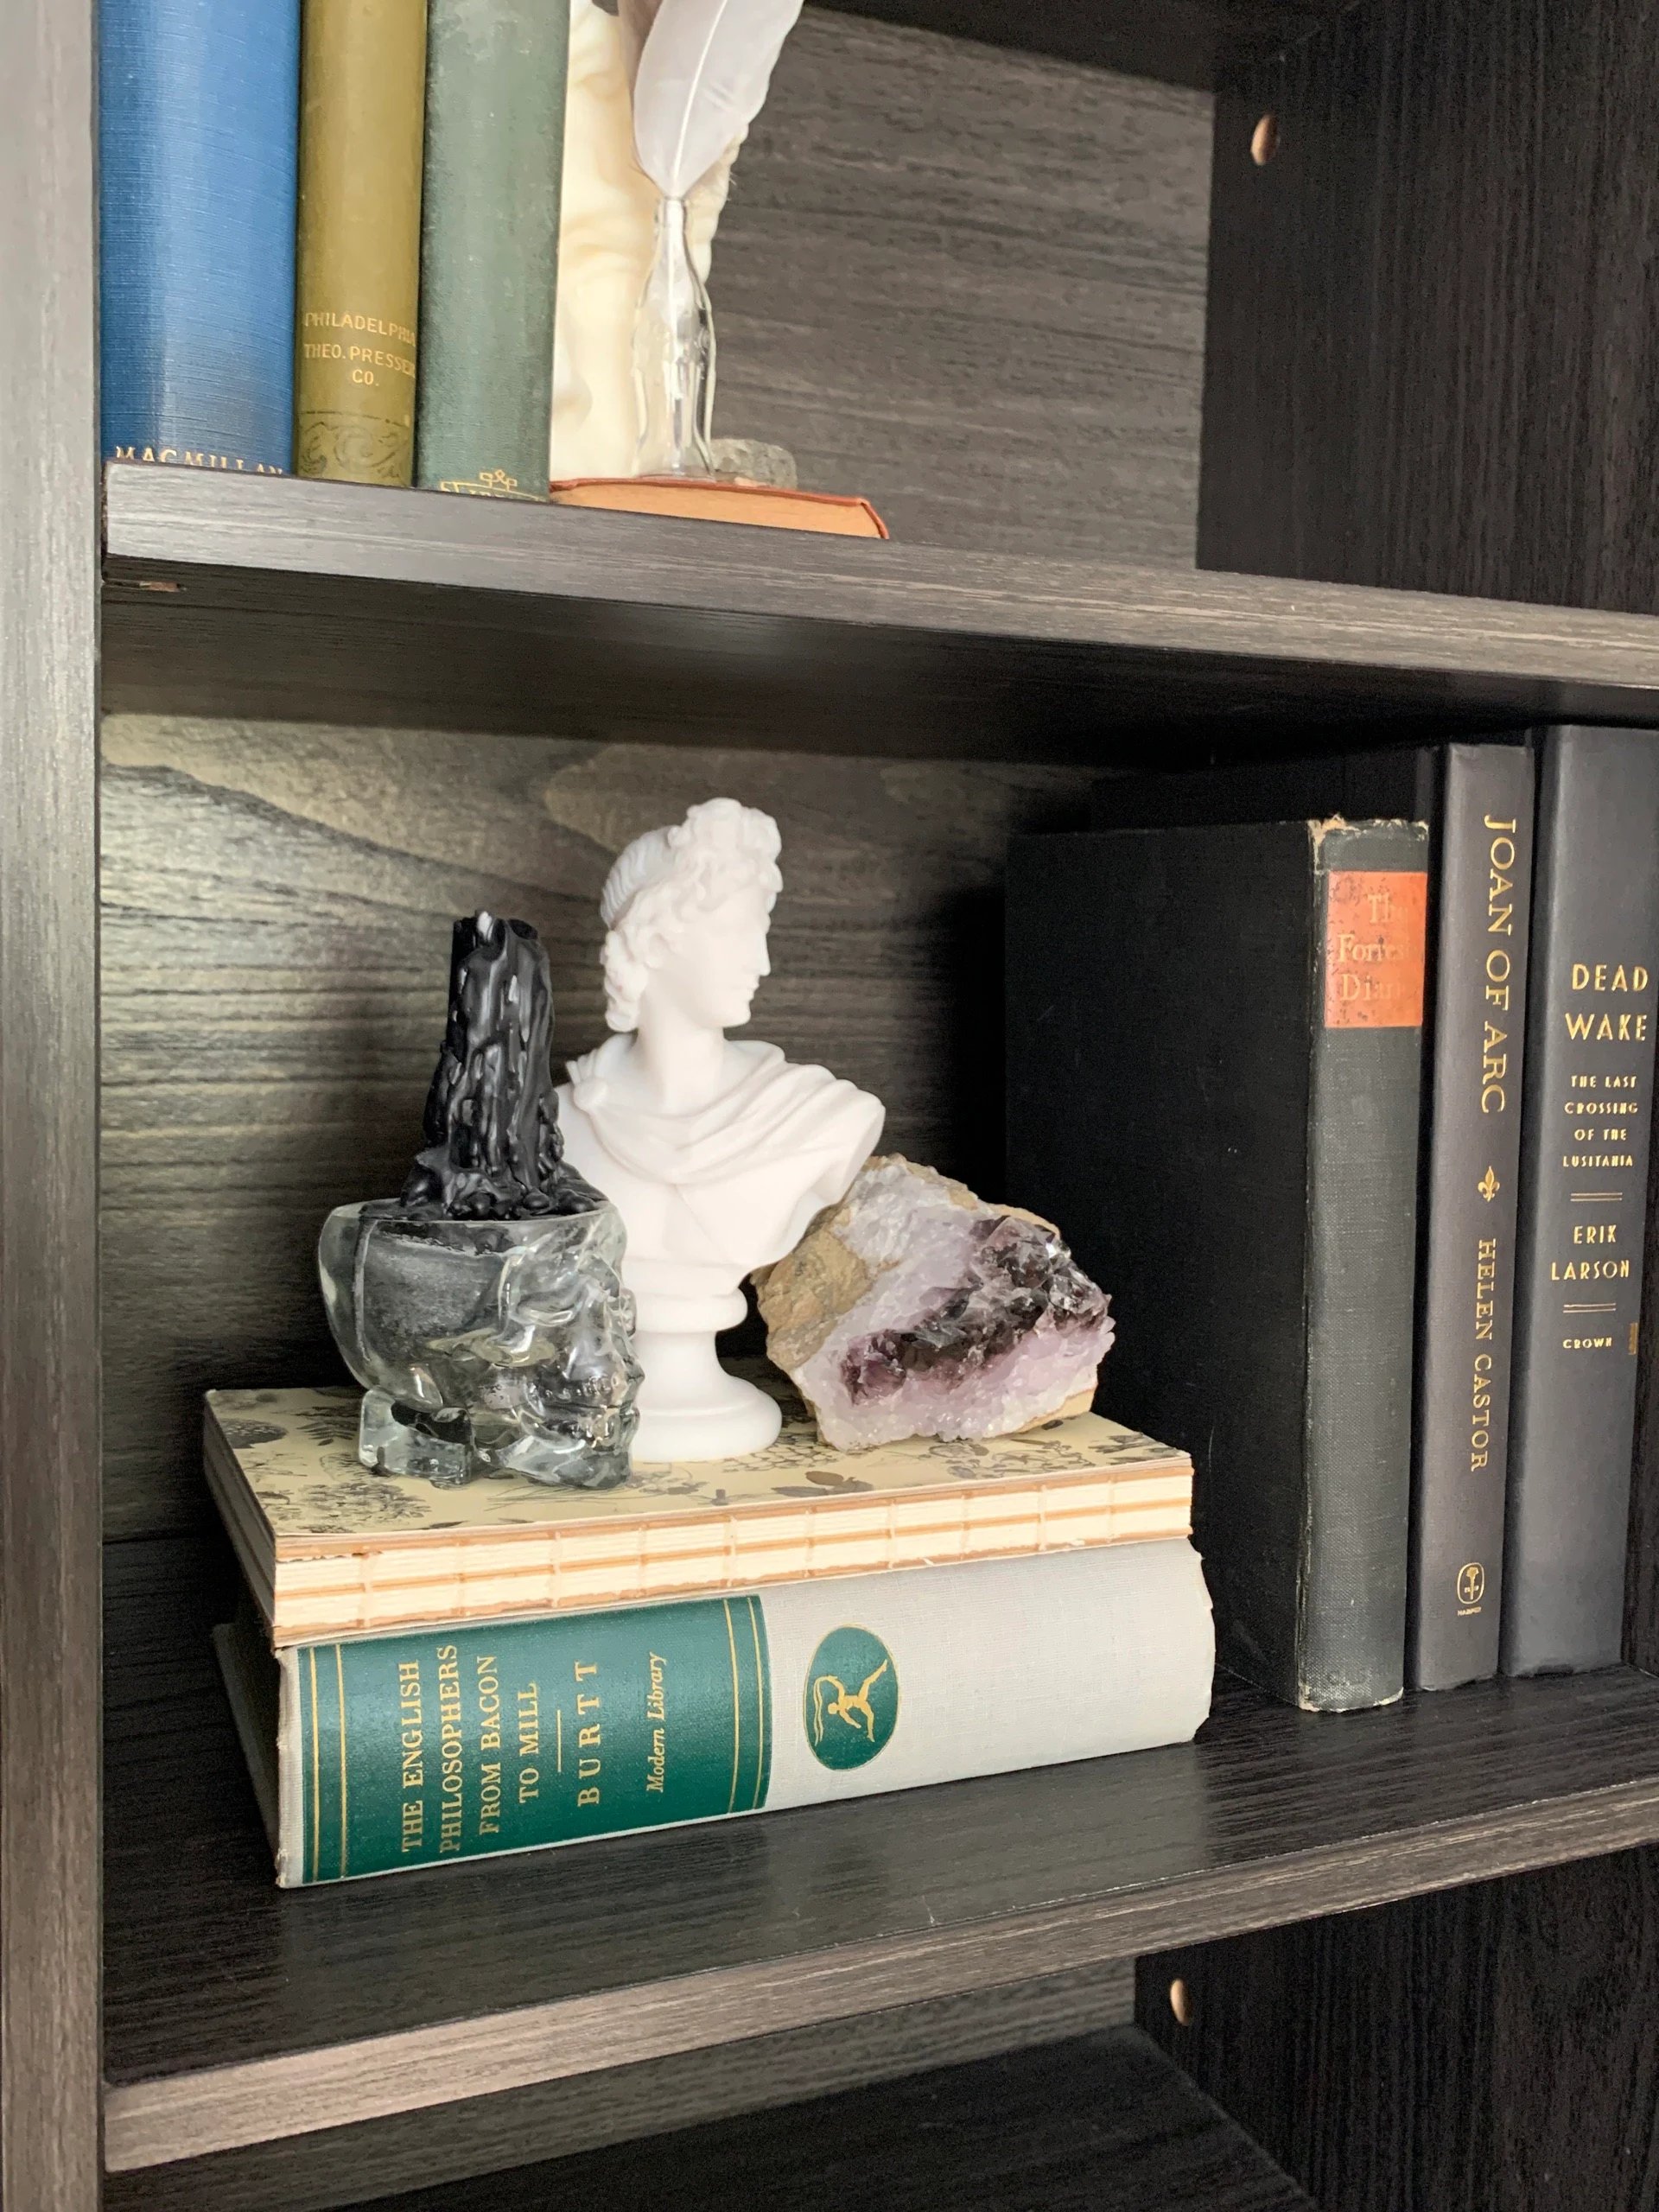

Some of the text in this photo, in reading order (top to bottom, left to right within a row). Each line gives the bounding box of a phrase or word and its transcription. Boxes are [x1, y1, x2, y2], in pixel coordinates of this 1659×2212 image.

[304, 343, 346, 359] THEO.
[352, 368, 379, 386] CO.
[1481, 814, 1516, 1114] JOAN OF ARC
[1571, 963, 1649, 993] DEAD
[1564, 1013, 1649, 1041] WAKE
[1571, 1075, 1637, 1088] THE LAST
[1564, 1102, 1638, 1115] CROSSING
[1574, 1128, 1627, 1141] OF THE
[1562, 1155, 1633, 1167] LUSITANIA
[1573, 1224, 1617, 1244] ERIK
[1551, 1260, 1630, 1281] LARSON
[1471, 1237, 1497, 1472] HELEN CASTOR
[1562, 1338, 1612, 1349] CROWN
[575, 1659, 601, 1808] BURTT
[646, 1651, 667, 1794] Modern Library
[398, 1659, 423, 1853] THE ENGLISH
[436, 1644, 463, 1853] PHILOSOPHERS
[476, 1655, 502, 1836] FROM BACON
[518, 1681, 540, 1804] TO MILL
